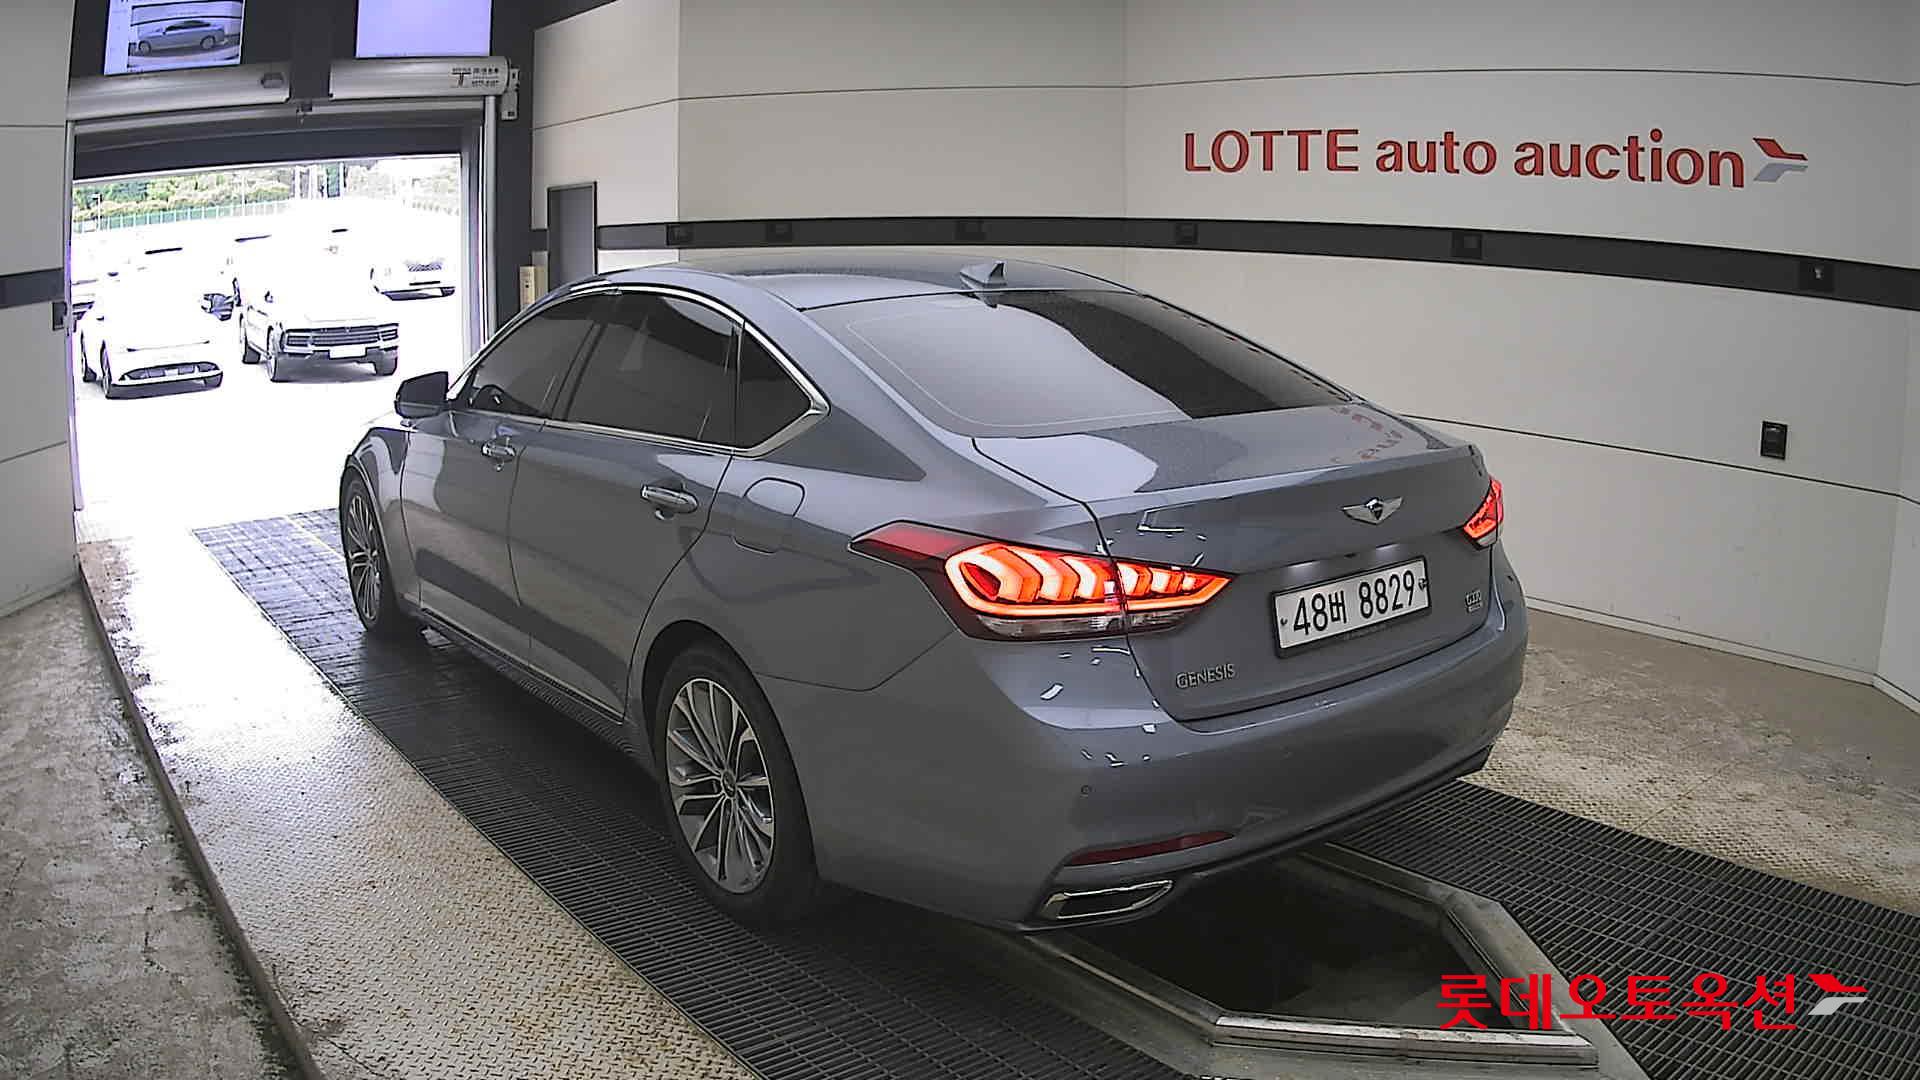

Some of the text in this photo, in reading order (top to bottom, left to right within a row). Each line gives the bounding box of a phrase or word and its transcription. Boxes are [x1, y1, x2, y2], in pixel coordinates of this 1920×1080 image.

[1184, 128, 1745, 188] LOTTE auto auction
[1293, 570, 1415, 635] 48버 8829
[1176, 663, 1236, 689] GENESIS
